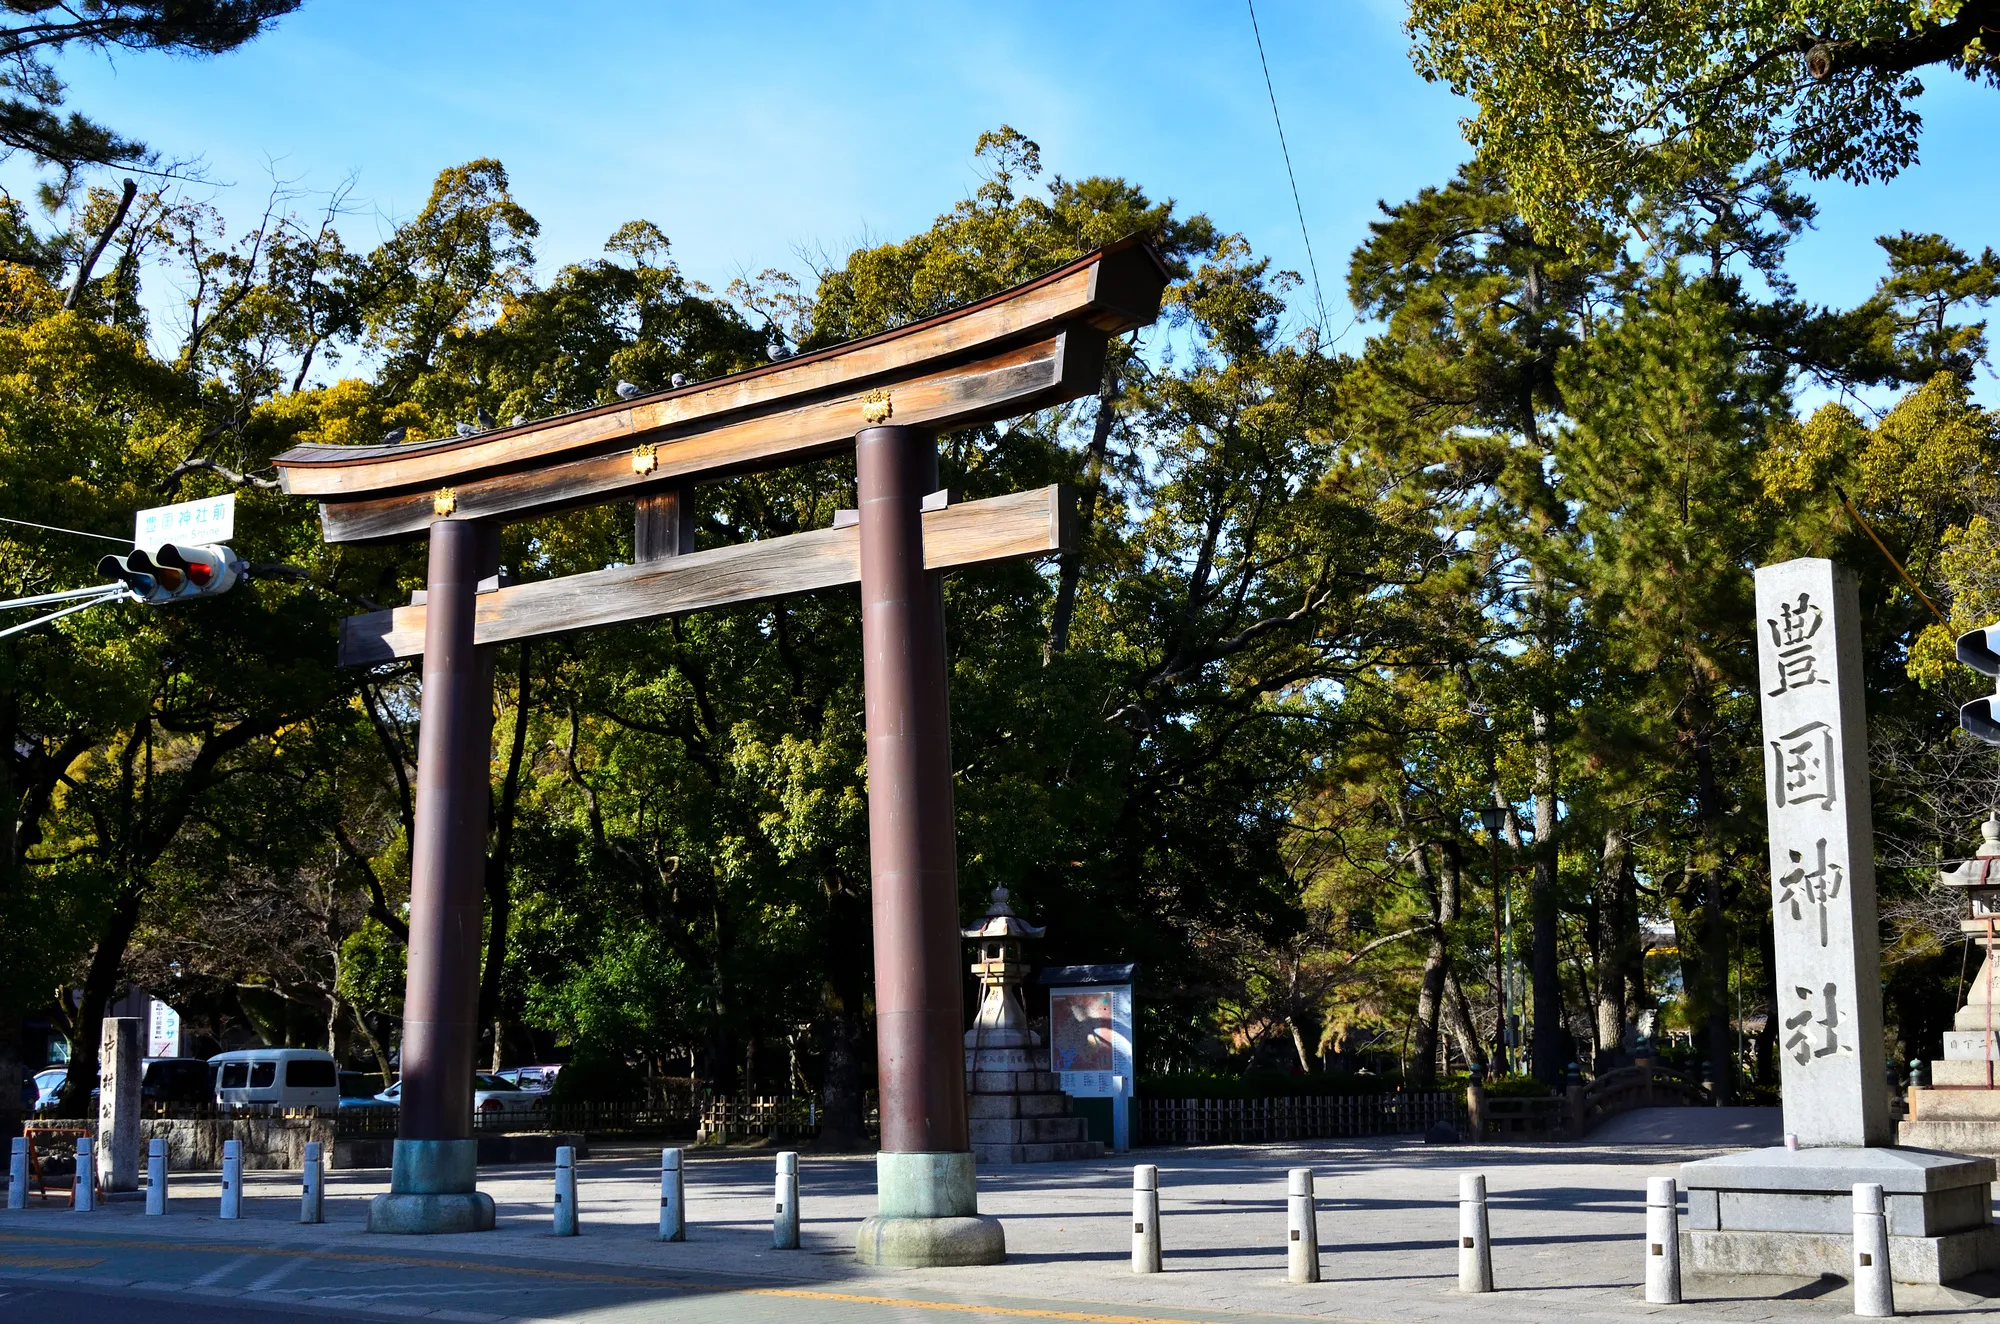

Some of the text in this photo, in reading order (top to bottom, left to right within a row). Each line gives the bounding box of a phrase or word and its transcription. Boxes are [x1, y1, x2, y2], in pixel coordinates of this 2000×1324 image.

[145, 502, 226, 533] 豊国神社前
[191, 527, 220, 539] Shrine
[101, 1035, 115, 1152] 中村公園
